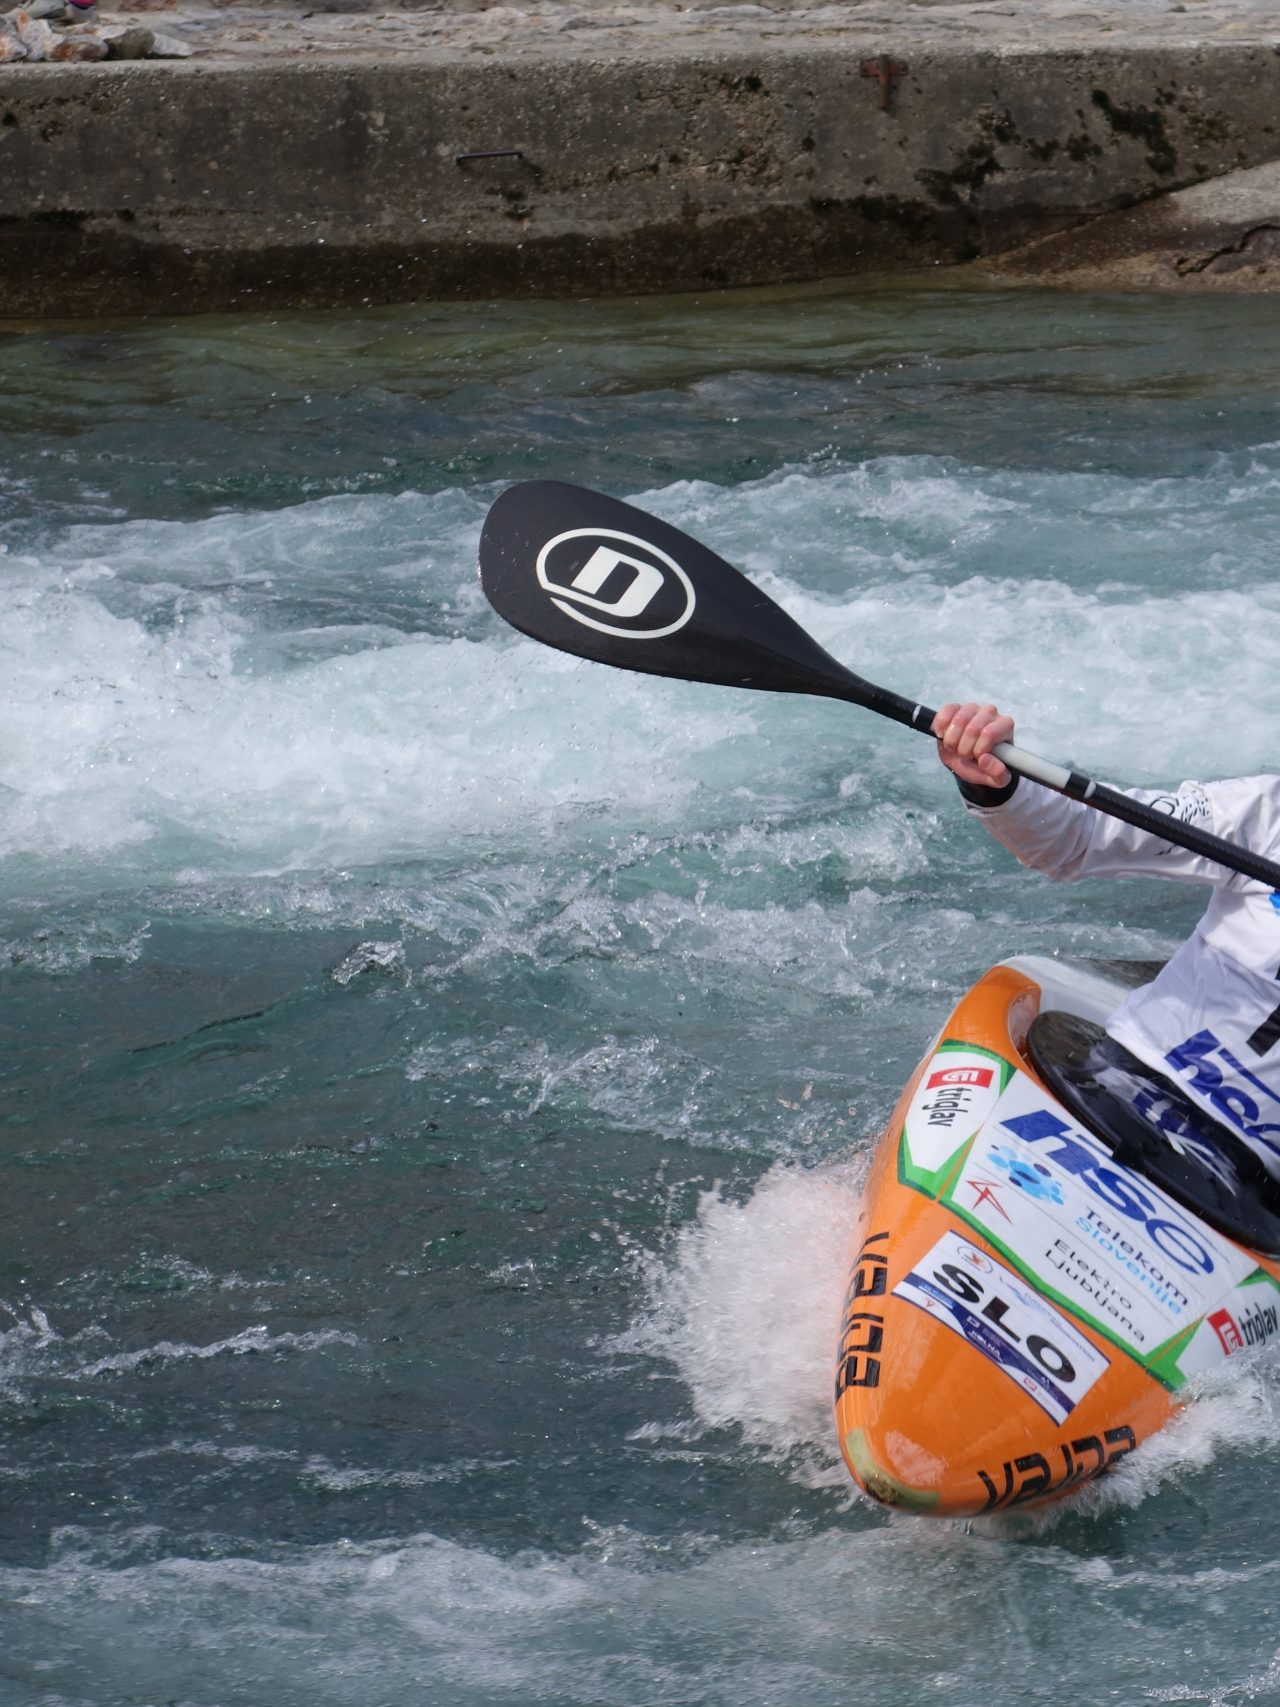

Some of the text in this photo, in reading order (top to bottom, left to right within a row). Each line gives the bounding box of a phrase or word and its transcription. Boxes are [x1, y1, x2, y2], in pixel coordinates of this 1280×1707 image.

[921, 1086, 973, 1128] triglav
[1044, 1249, 1147, 1343] Ljubljana
[1053, 1238, 1133, 1311] Elektro
[1075, 1216, 1182, 1315] Slovenije
[1085, 1205, 1189, 1307] Telekom
[932, 1263, 1077, 1383] SLO
[1237, 1301, 1279, 1347] triglav
